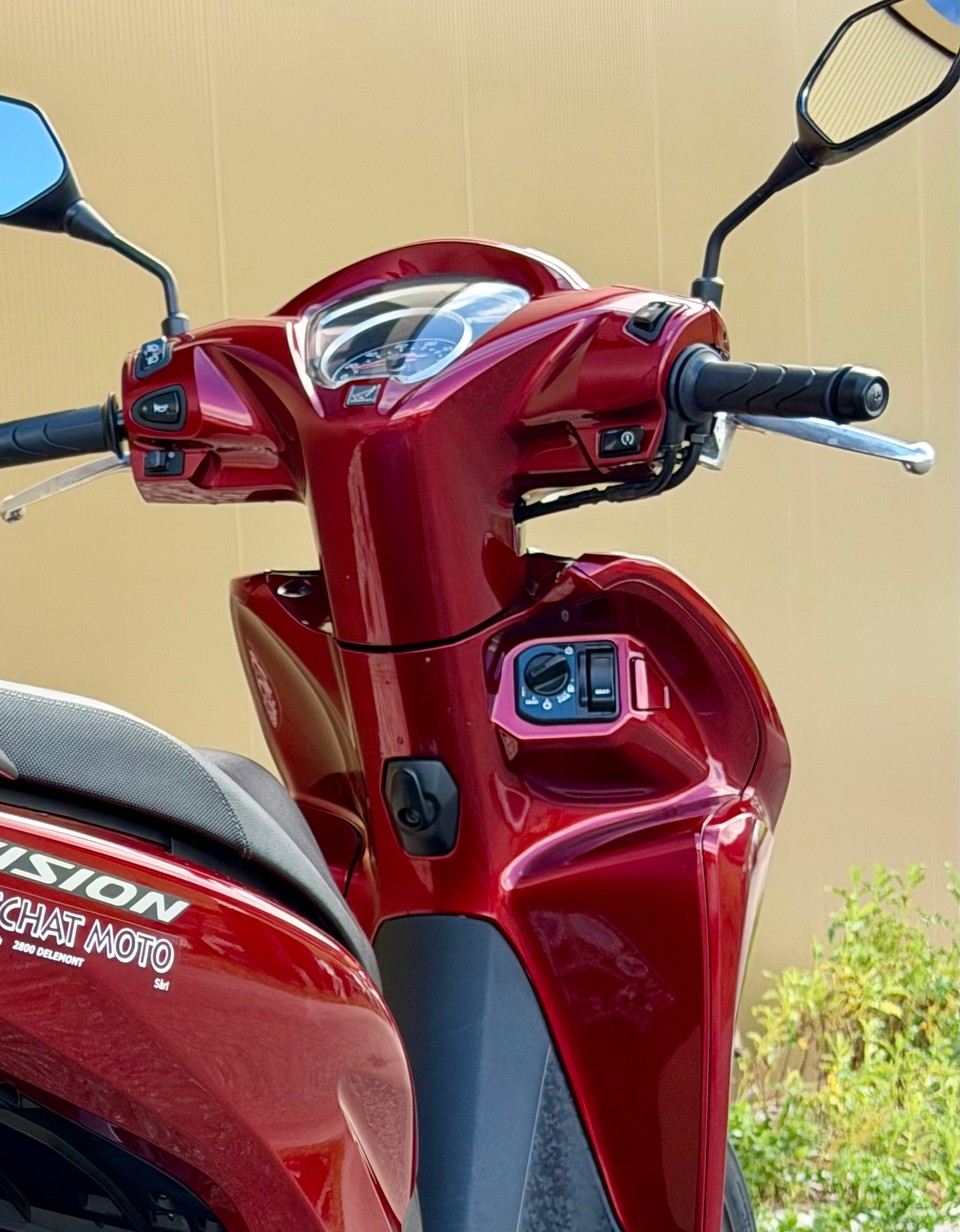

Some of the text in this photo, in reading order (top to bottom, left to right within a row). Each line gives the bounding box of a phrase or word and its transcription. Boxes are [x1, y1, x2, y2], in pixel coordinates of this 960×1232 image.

[12, 940, 85, 968] 2800 DELEMONT
[84, 919, 175, 974] MOTO
